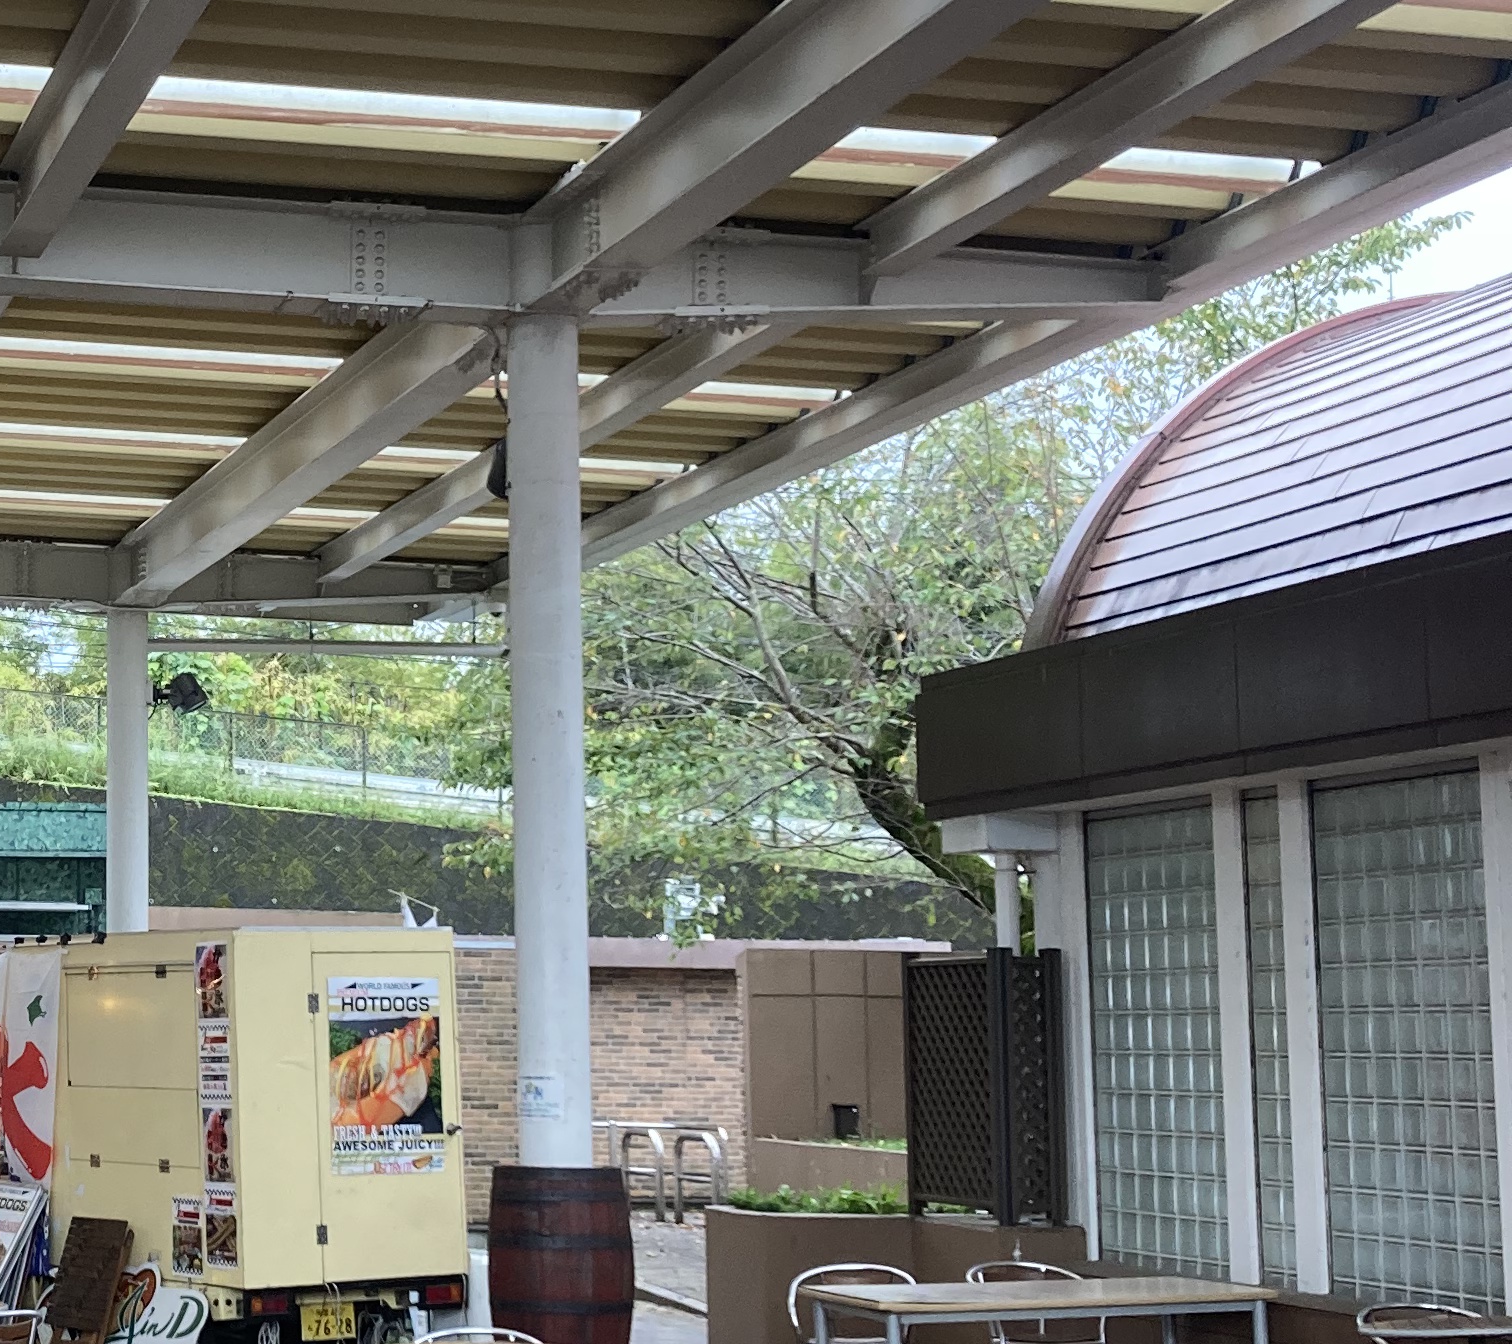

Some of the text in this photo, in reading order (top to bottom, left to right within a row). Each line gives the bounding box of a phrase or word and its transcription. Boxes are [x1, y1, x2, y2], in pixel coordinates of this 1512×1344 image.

[341, 996, 430, 1012] HOTDOGS
[333, 1125, 366, 1141] FRESH
[370, 1124, 379, 1140] &
[333, 1140, 396, 1152] AWESOME
